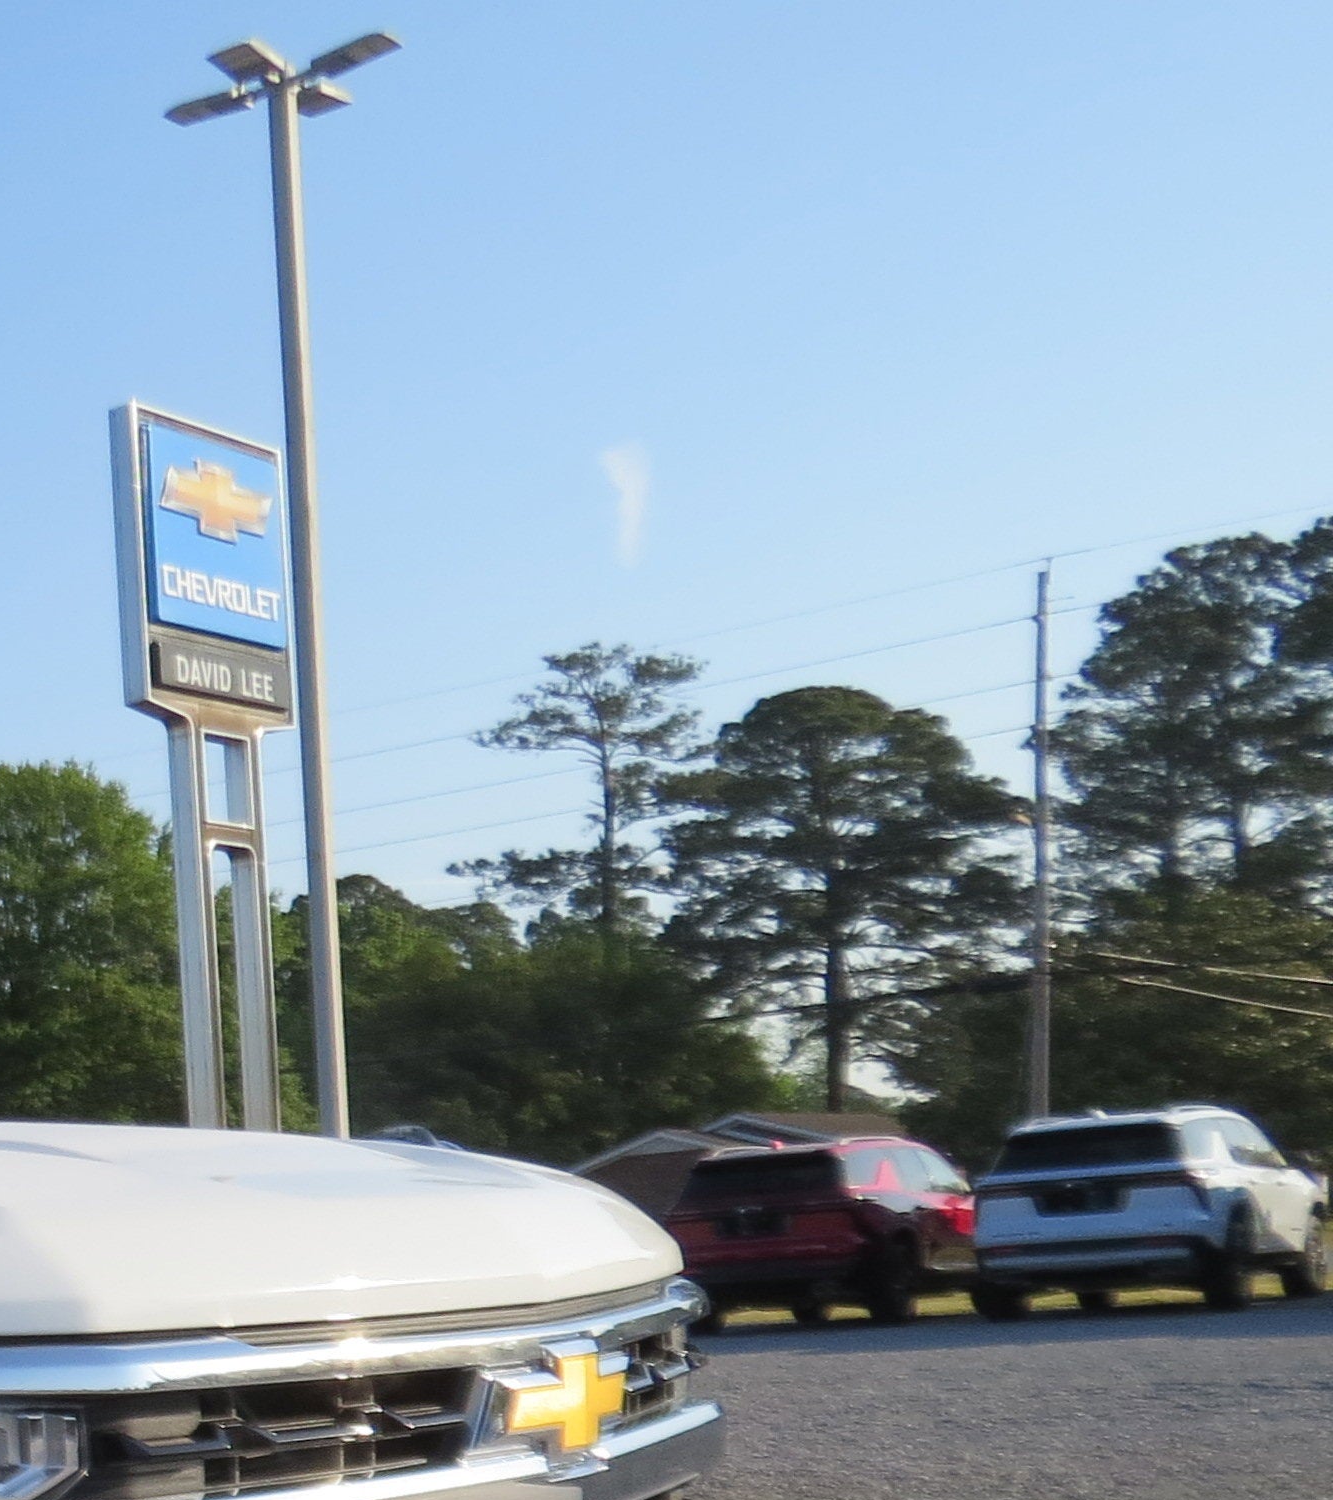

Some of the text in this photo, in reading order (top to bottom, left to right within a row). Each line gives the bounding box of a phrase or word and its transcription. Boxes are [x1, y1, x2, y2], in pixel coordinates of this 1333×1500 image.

[161, 564, 281, 622] CHEVROLET
[176, 655, 274, 702] DAVID LEE
